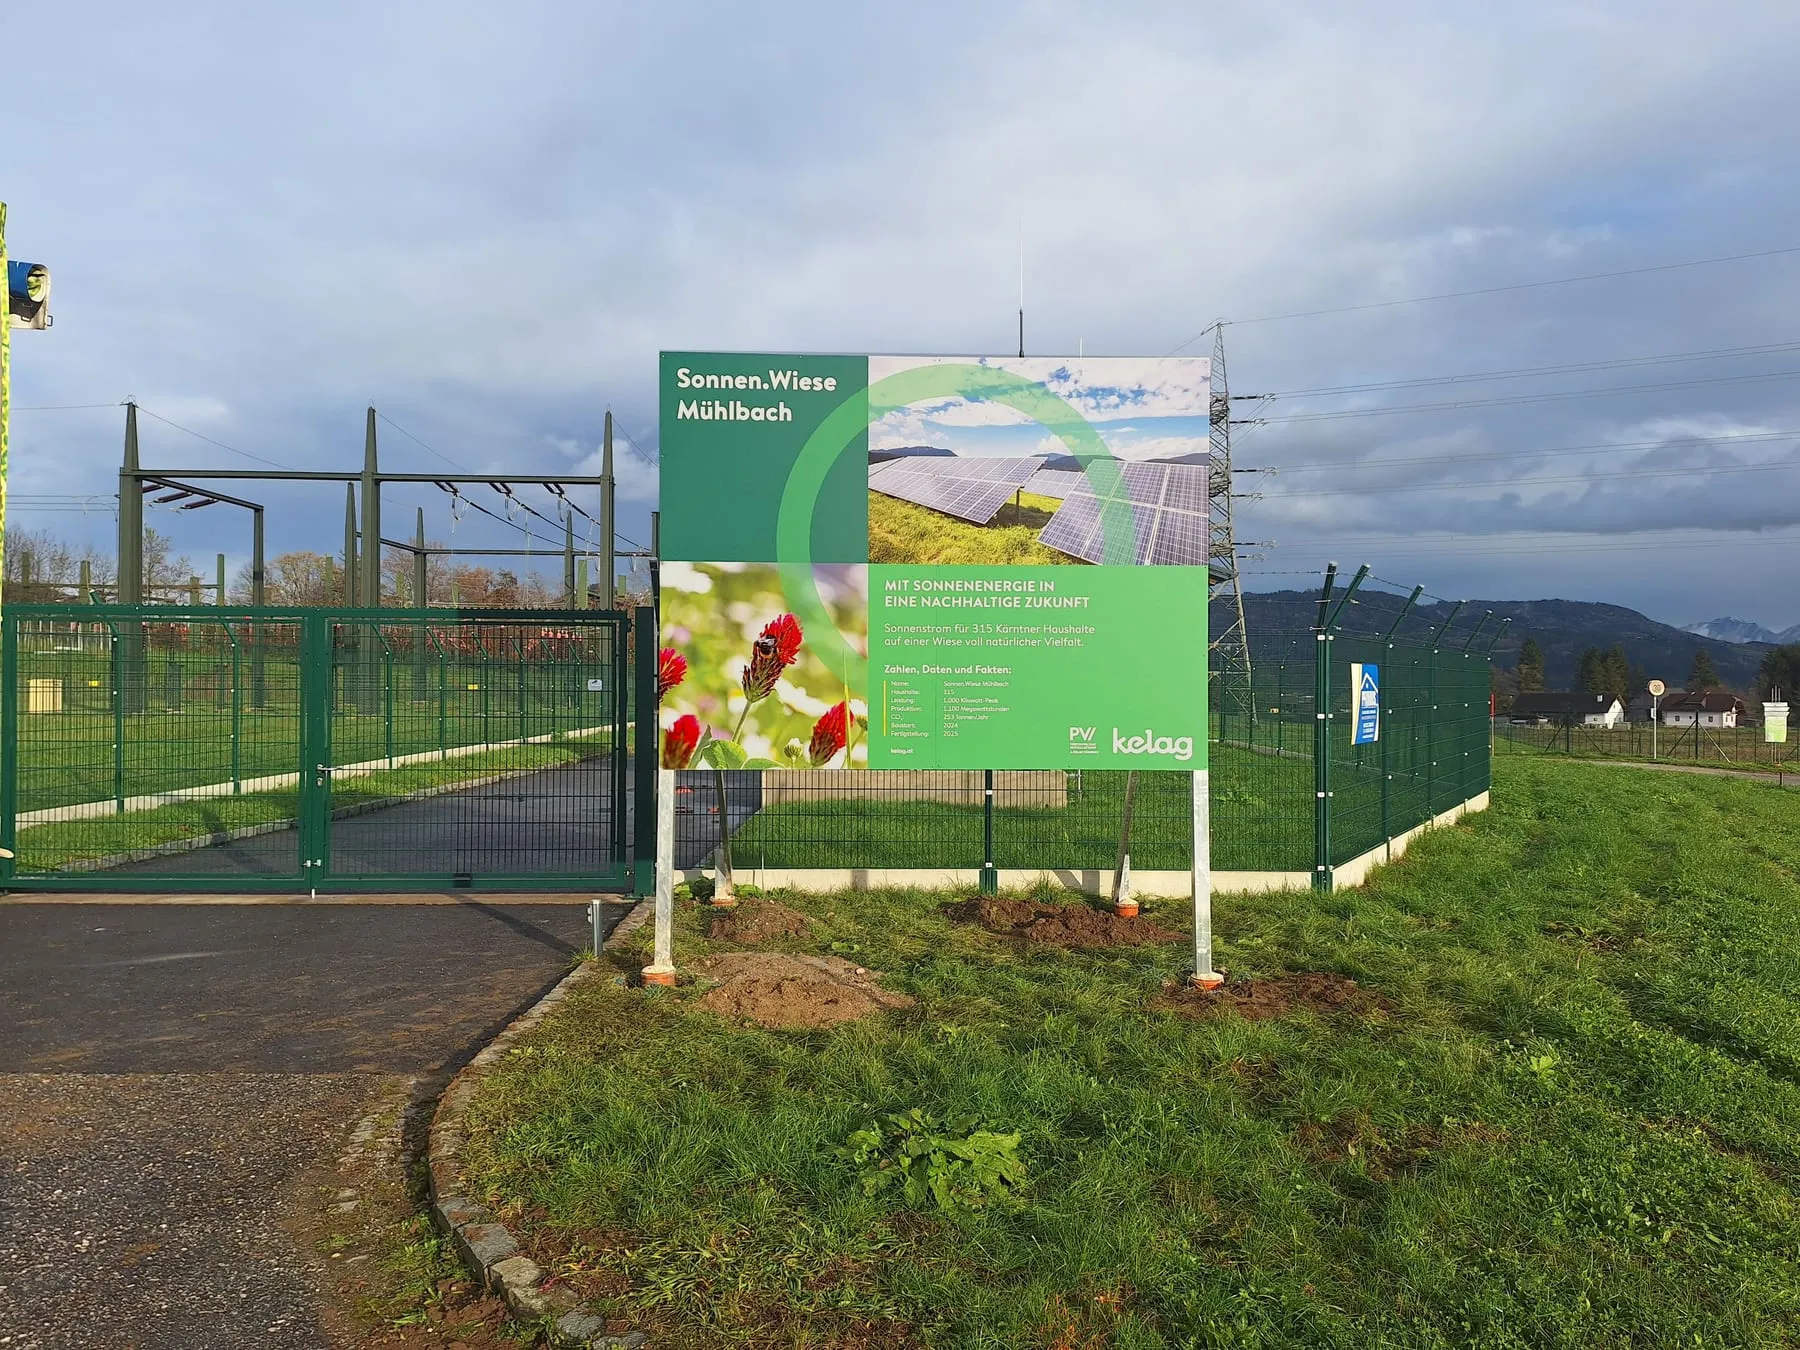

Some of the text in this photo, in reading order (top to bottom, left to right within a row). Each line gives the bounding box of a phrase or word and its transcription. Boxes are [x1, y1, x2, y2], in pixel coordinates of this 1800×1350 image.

[676, 368, 837, 391] Sonnen.Wiese
[676, 399, 793, 422] Mühlbach
[885, 580, 1055, 592] MIT SONNENENERGIE IN
[885, 595, 1090, 608] EINE NACHHALTIGE ZUKUNFT
[884, 623, 1095, 634] Sonnenstrom für 315 Kärntner Haushalte
[884, 636, 1084, 647] auf einer Wiese voll natürlicher Vielfalt.
[884, 664, 1012, 675] Zahlen, Daten und Fakten:
[1112, 727, 1193, 760] kelag
